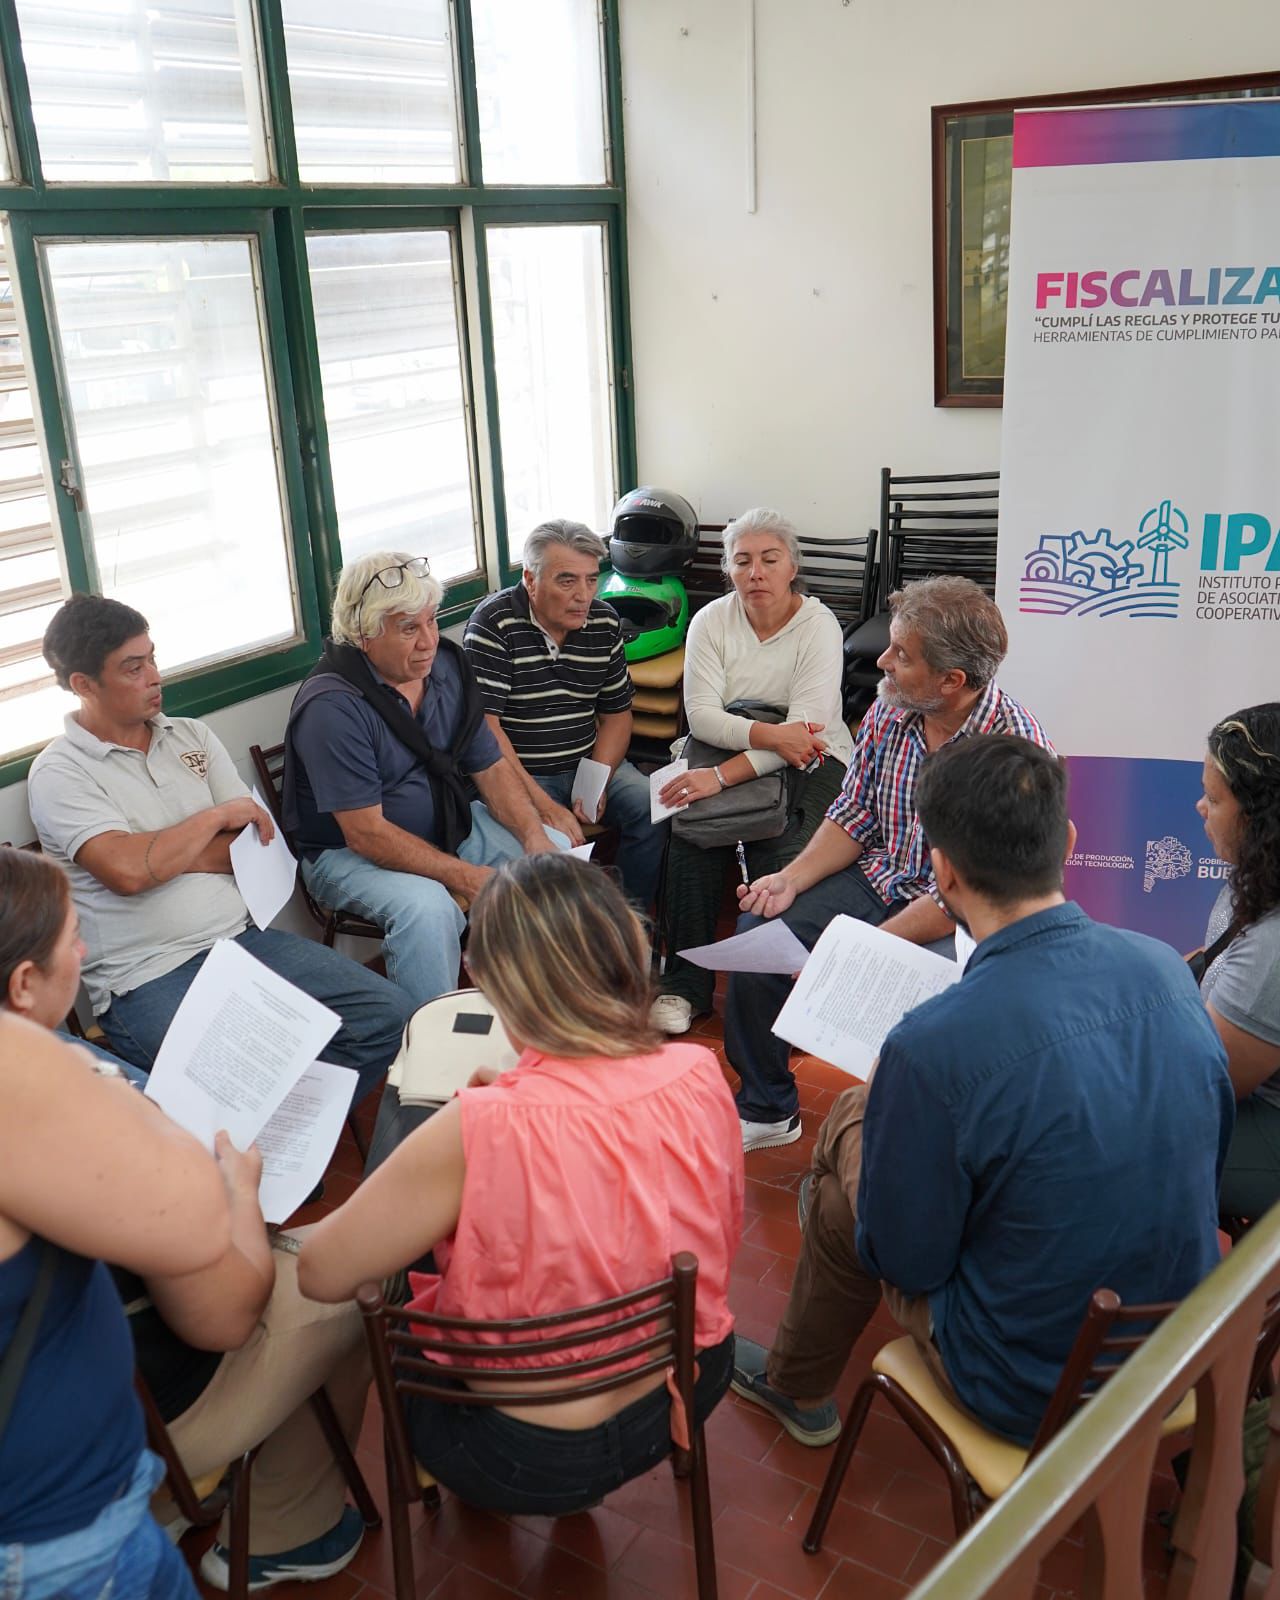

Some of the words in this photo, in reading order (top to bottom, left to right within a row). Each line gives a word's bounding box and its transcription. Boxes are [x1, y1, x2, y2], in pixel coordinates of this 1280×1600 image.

[1036, 266, 1280, 309] FISCALIZA
[1096, 315, 1121, 327] LAS
[1125, 314, 1177, 327] REGLAS
[1179, 314, 1190, 325] Y
[1193, 312, 1257, 325] PROTEGE
[1034, 330, 1133, 343] HERRAMIENTAS
[1136, 330, 1153, 341] DE
[1156, 328, 1257, 341] CUMPLIMIENTO
[1261, 327, 1280, 339] PA
[1200, 512, 1280, 571] IP
[1198, 575, 1271, 589] INSTITUTO
[1197, 591, 1216, 604] DE
